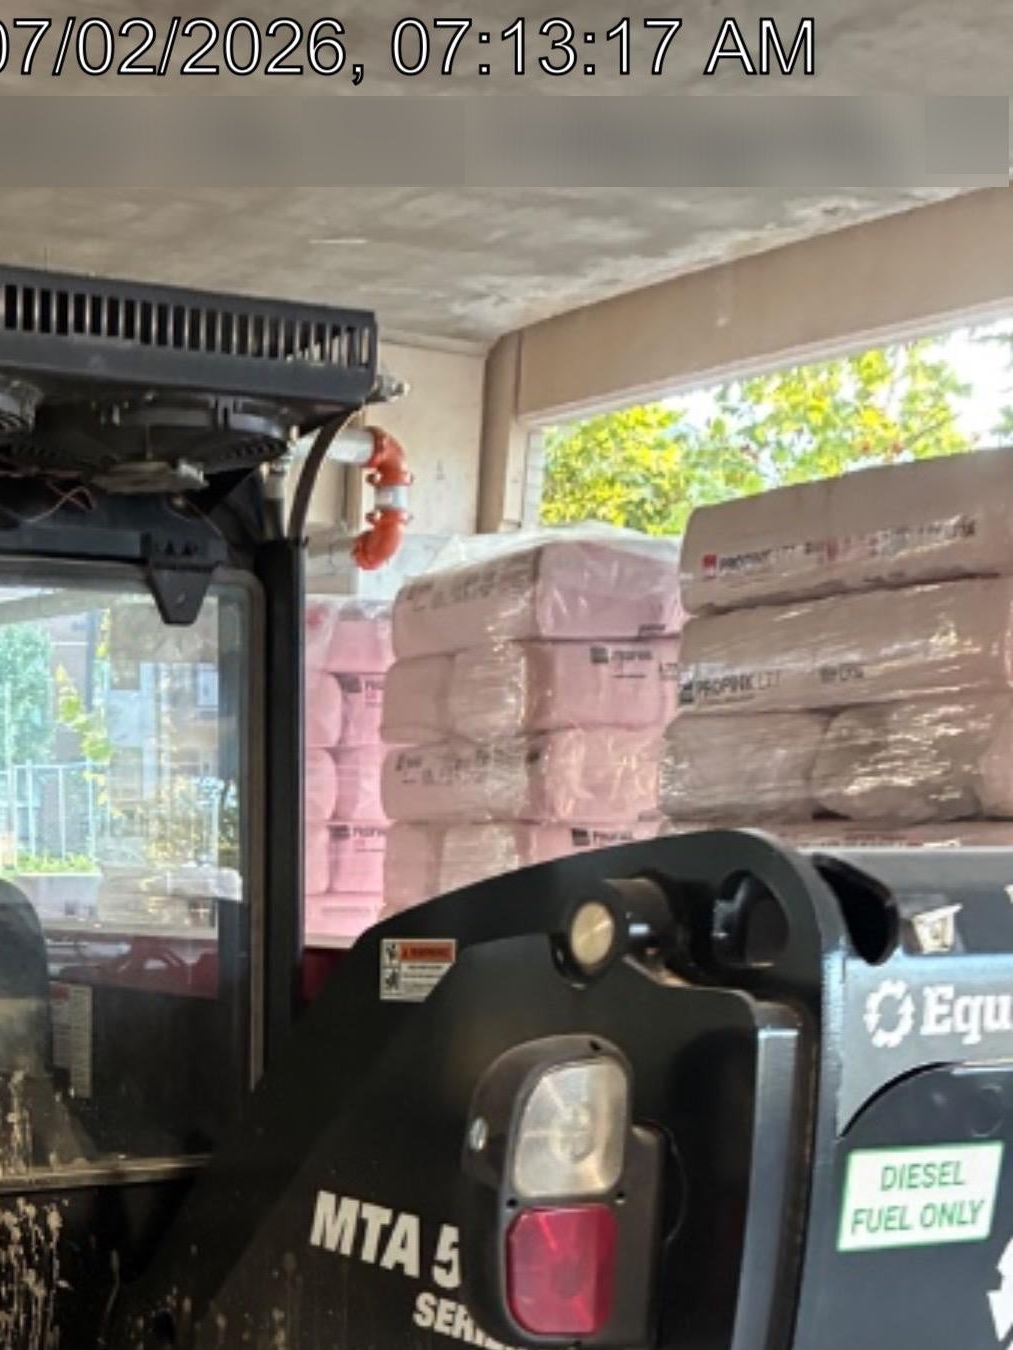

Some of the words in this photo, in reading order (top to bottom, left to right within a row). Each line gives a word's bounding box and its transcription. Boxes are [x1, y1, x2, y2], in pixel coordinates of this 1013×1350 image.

[919, 984, 1012, 1046] Equ
[879, 1160, 965, 1192] DIESEL
[310, 1189, 420, 1279] MTA
[851, 1205, 912, 1236] FUEL
[919, 1199, 985, 1228] ONLY
